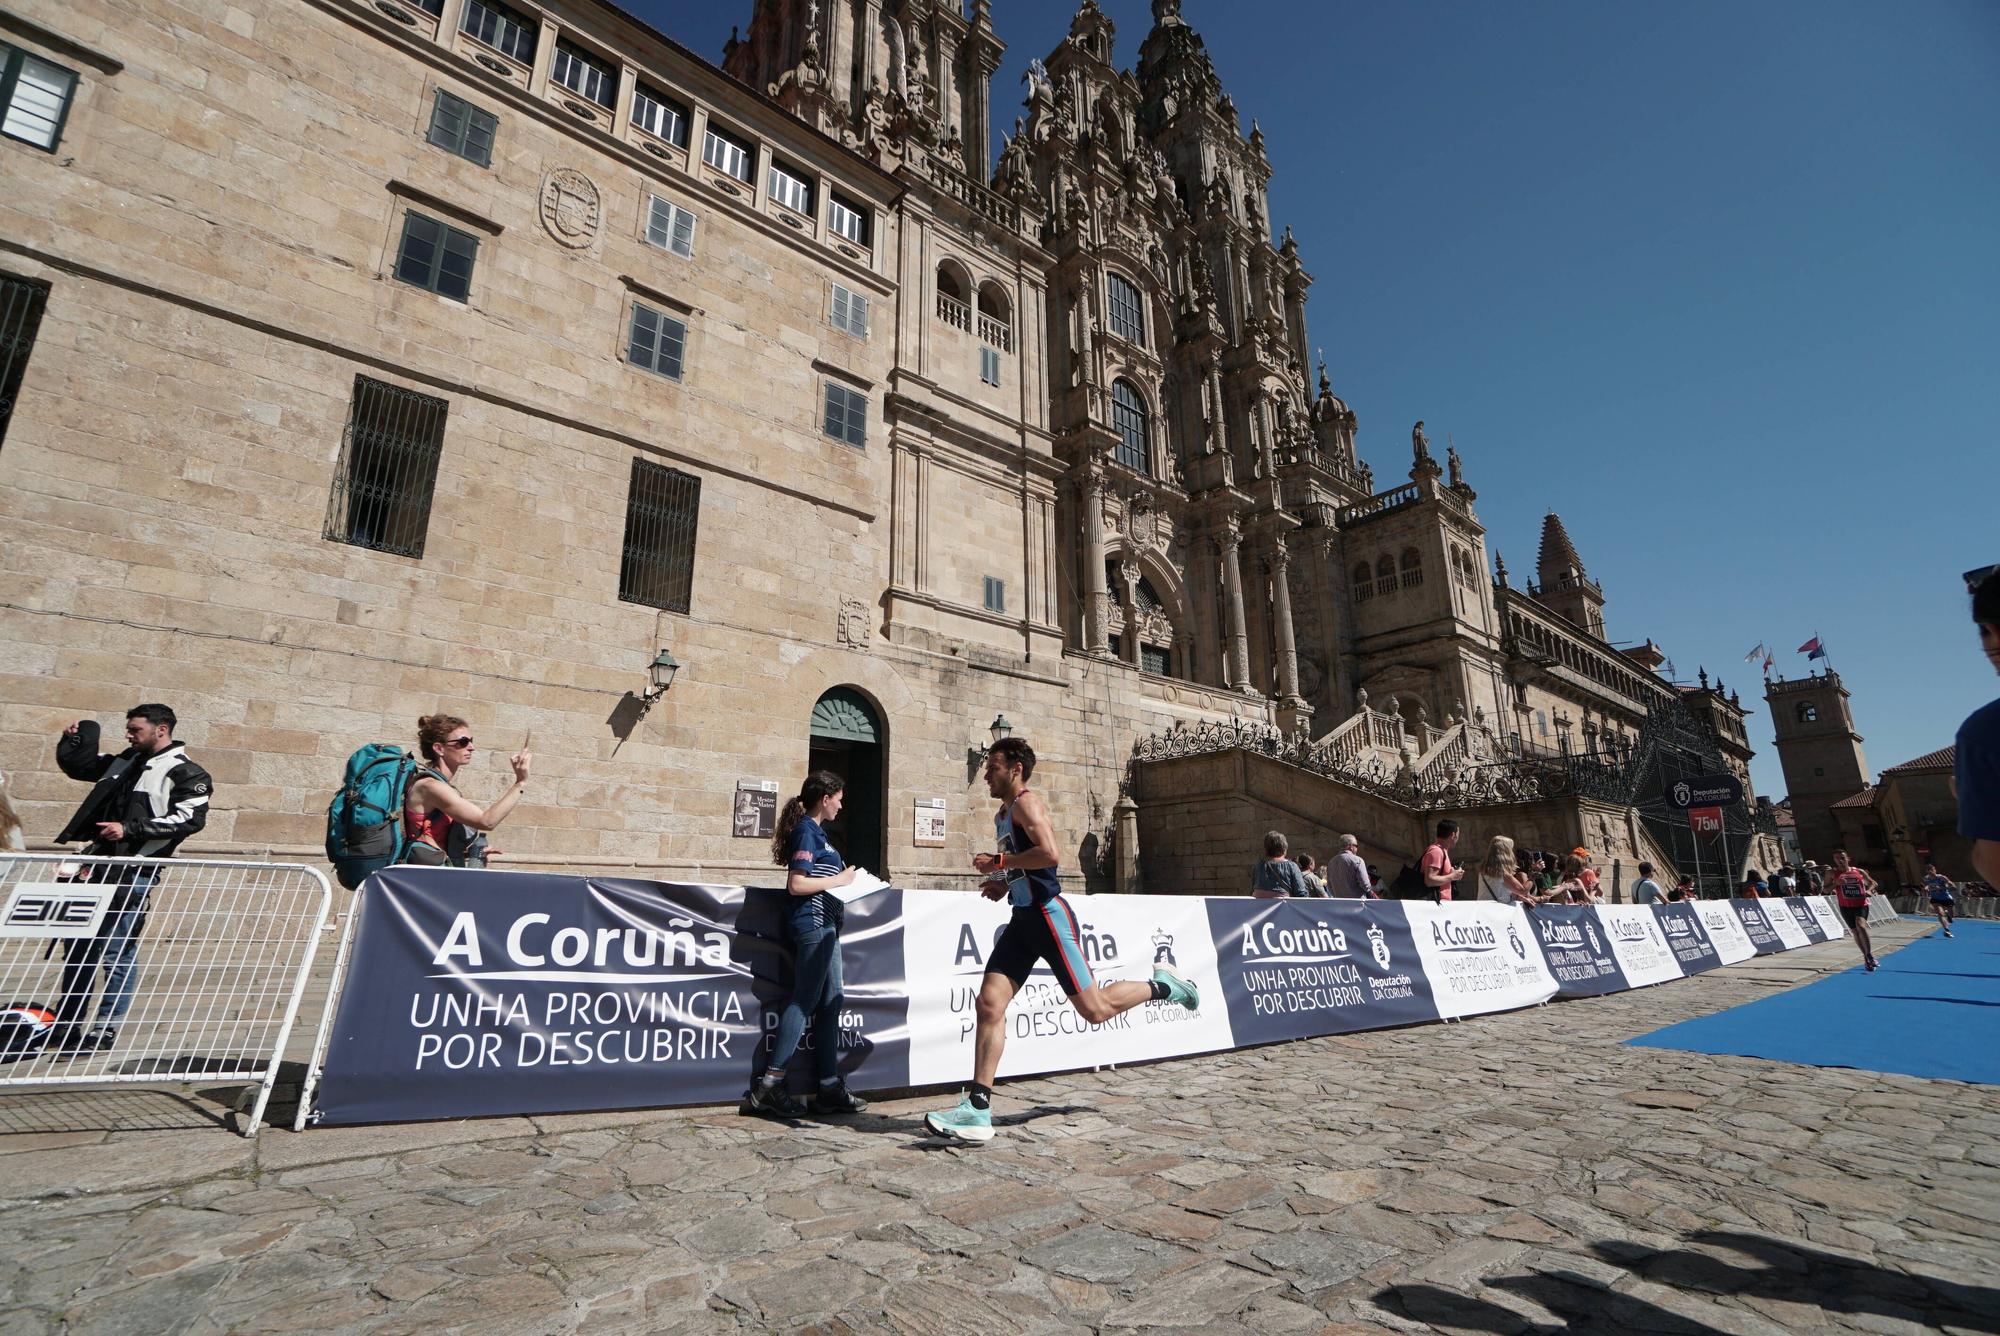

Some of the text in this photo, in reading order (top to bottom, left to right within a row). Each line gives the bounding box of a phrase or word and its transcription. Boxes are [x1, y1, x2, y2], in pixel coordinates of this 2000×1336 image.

[1693, 788, 1731, 797] Deputación
[433, 912, 731, 967] A Coruña
[954, 923, 984, 966] A
[1242, 921, 1348, 956] A Coruña
[1430, 920, 1496, 946] A Coruña
[1243, 964, 1362, 992] UNHA PROVINCIA
[1368, 973, 1412, 990] Deputación
[1372, 985, 1414, 1000] DA CORUÑA
[410, 991, 744, 1028] UNHA PROVINCIA
[1253, 985, 1365, 1016] POR DESCUBRIR
[1145, 1010, 1161, 1024] DA
[416, 1033, 502, 1070] POR
[517, 1028, 732, 1067] DESCUBRIR
